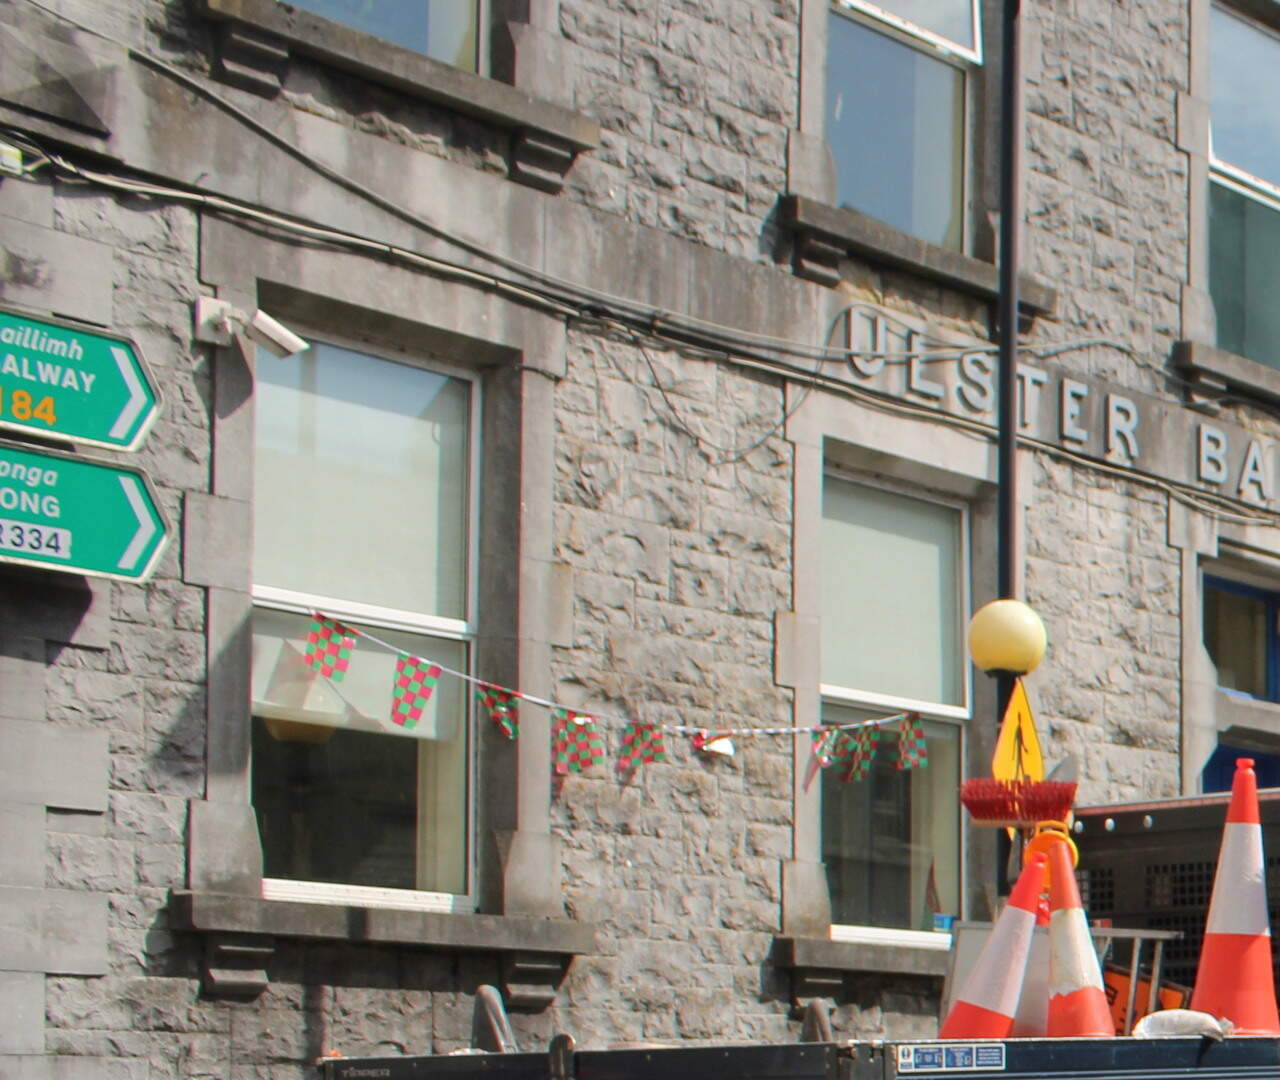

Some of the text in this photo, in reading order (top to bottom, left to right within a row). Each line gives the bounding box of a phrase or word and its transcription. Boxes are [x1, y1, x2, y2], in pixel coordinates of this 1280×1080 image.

[0, 325, 84, 361] aillimh
[1, 352, 96, 394] ALWAY
[845, 306, 1139, 460] ULSTER
[0, 386, 57, 426] 84
[0, 460, 58, 488] onga
[0, 487, 61, 519] ONG
